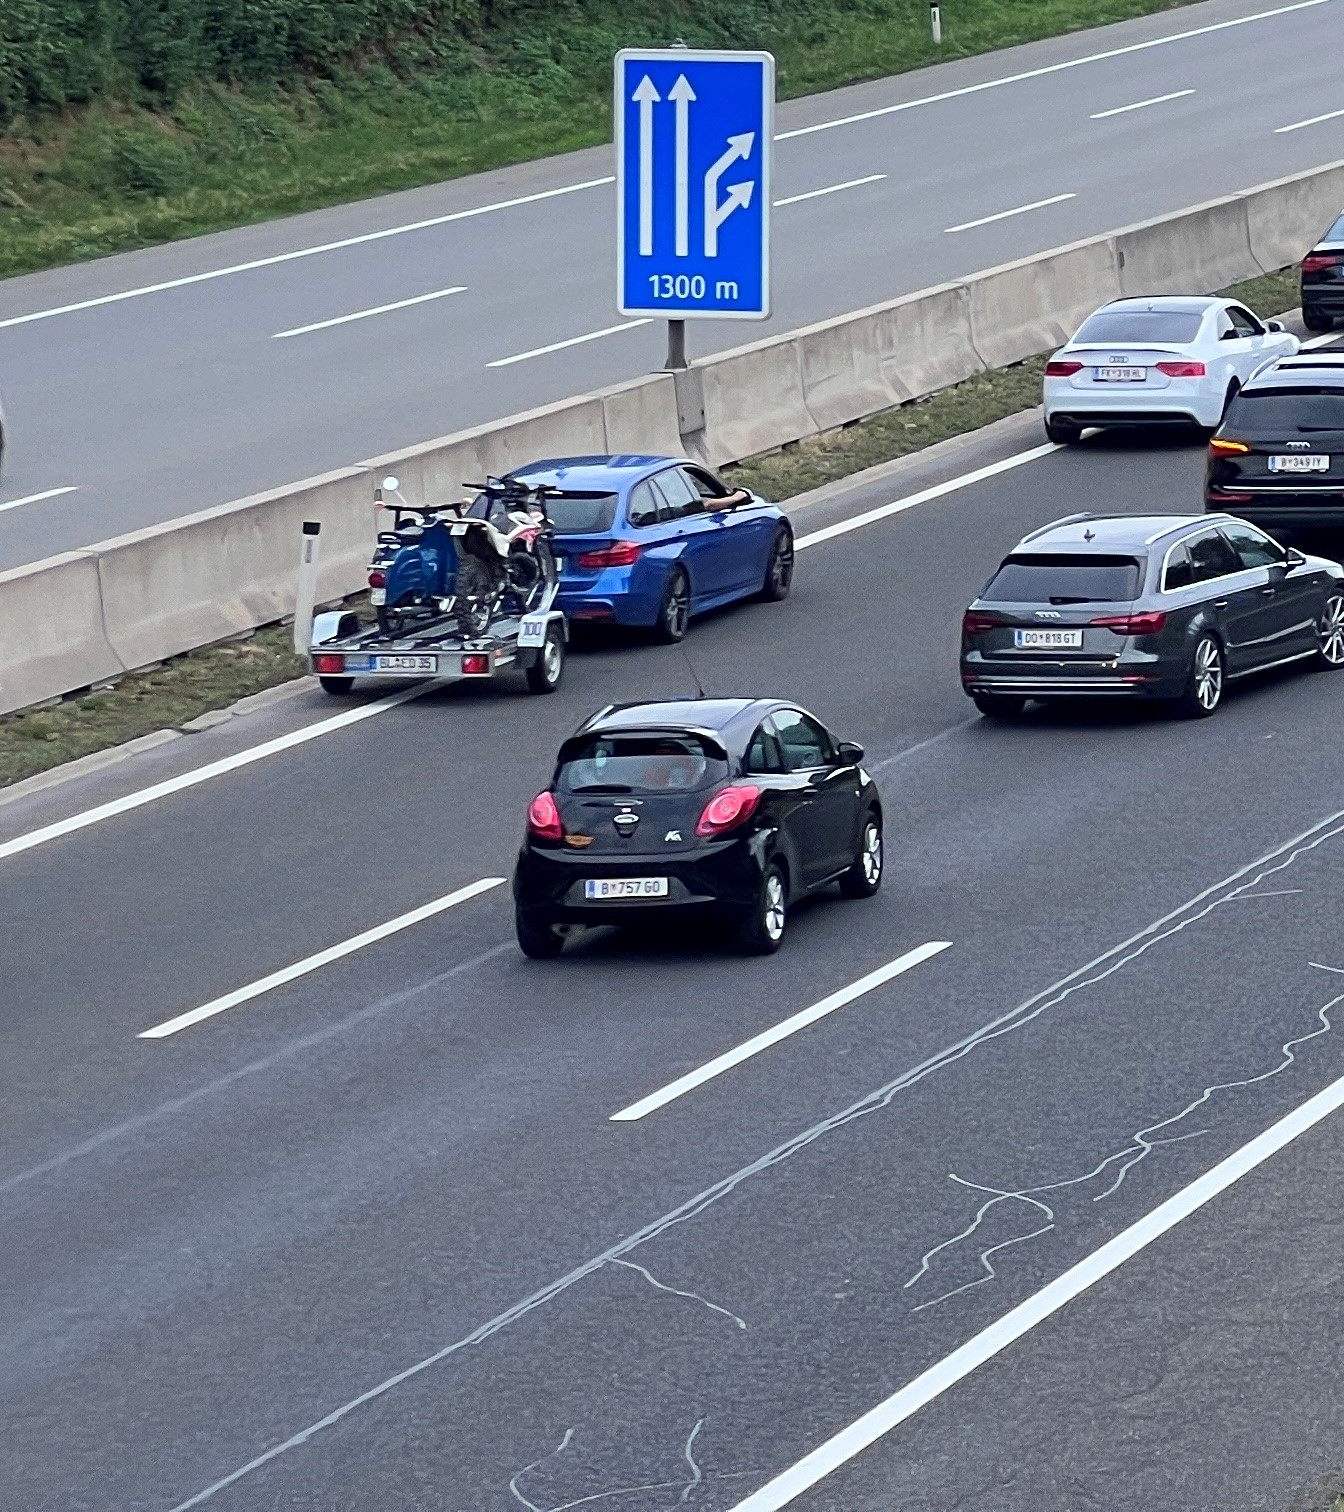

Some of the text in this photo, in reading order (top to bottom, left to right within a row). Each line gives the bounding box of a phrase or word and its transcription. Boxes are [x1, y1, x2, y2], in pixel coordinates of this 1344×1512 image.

[648, 274, 738, 300] 1300 m
[618, 881, 641, 894] 757
